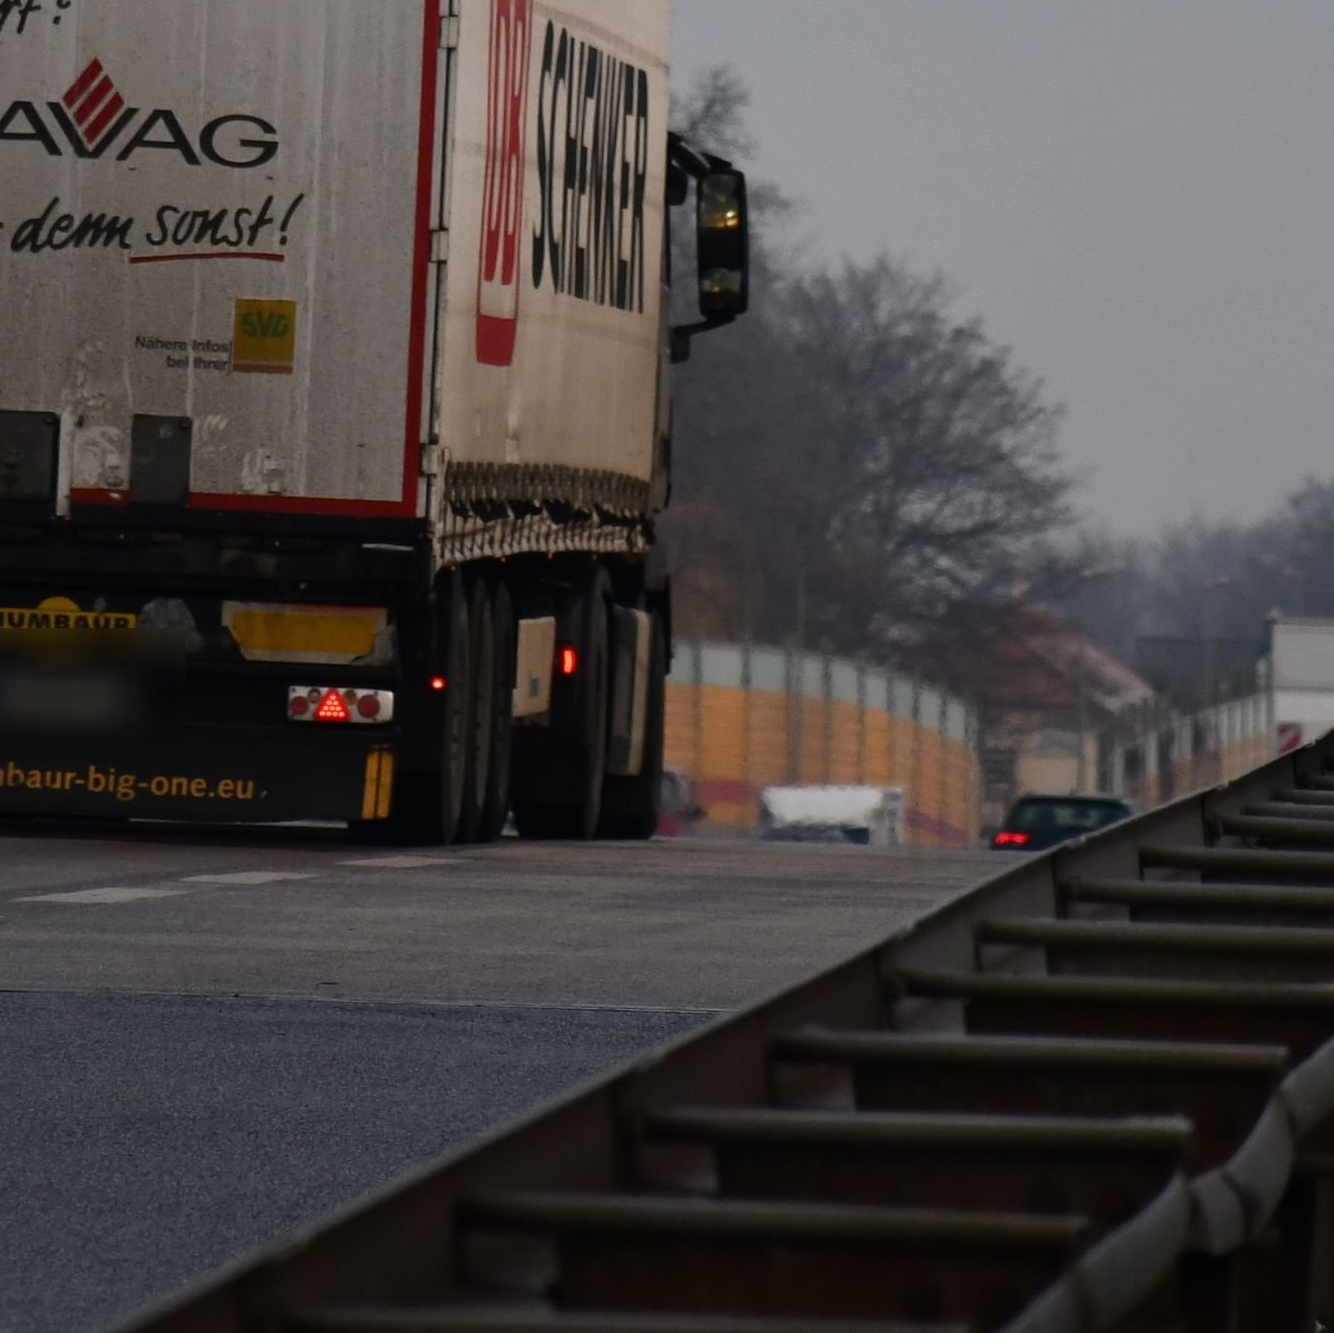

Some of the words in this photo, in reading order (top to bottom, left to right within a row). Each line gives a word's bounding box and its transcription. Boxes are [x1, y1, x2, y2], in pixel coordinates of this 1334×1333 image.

[532, 18, 650, 314] SCHENKER
[11, 197, 132, 253] denn
[135, 335, 187, 352] Nähere
[192, 339, 229, 353] Infos
